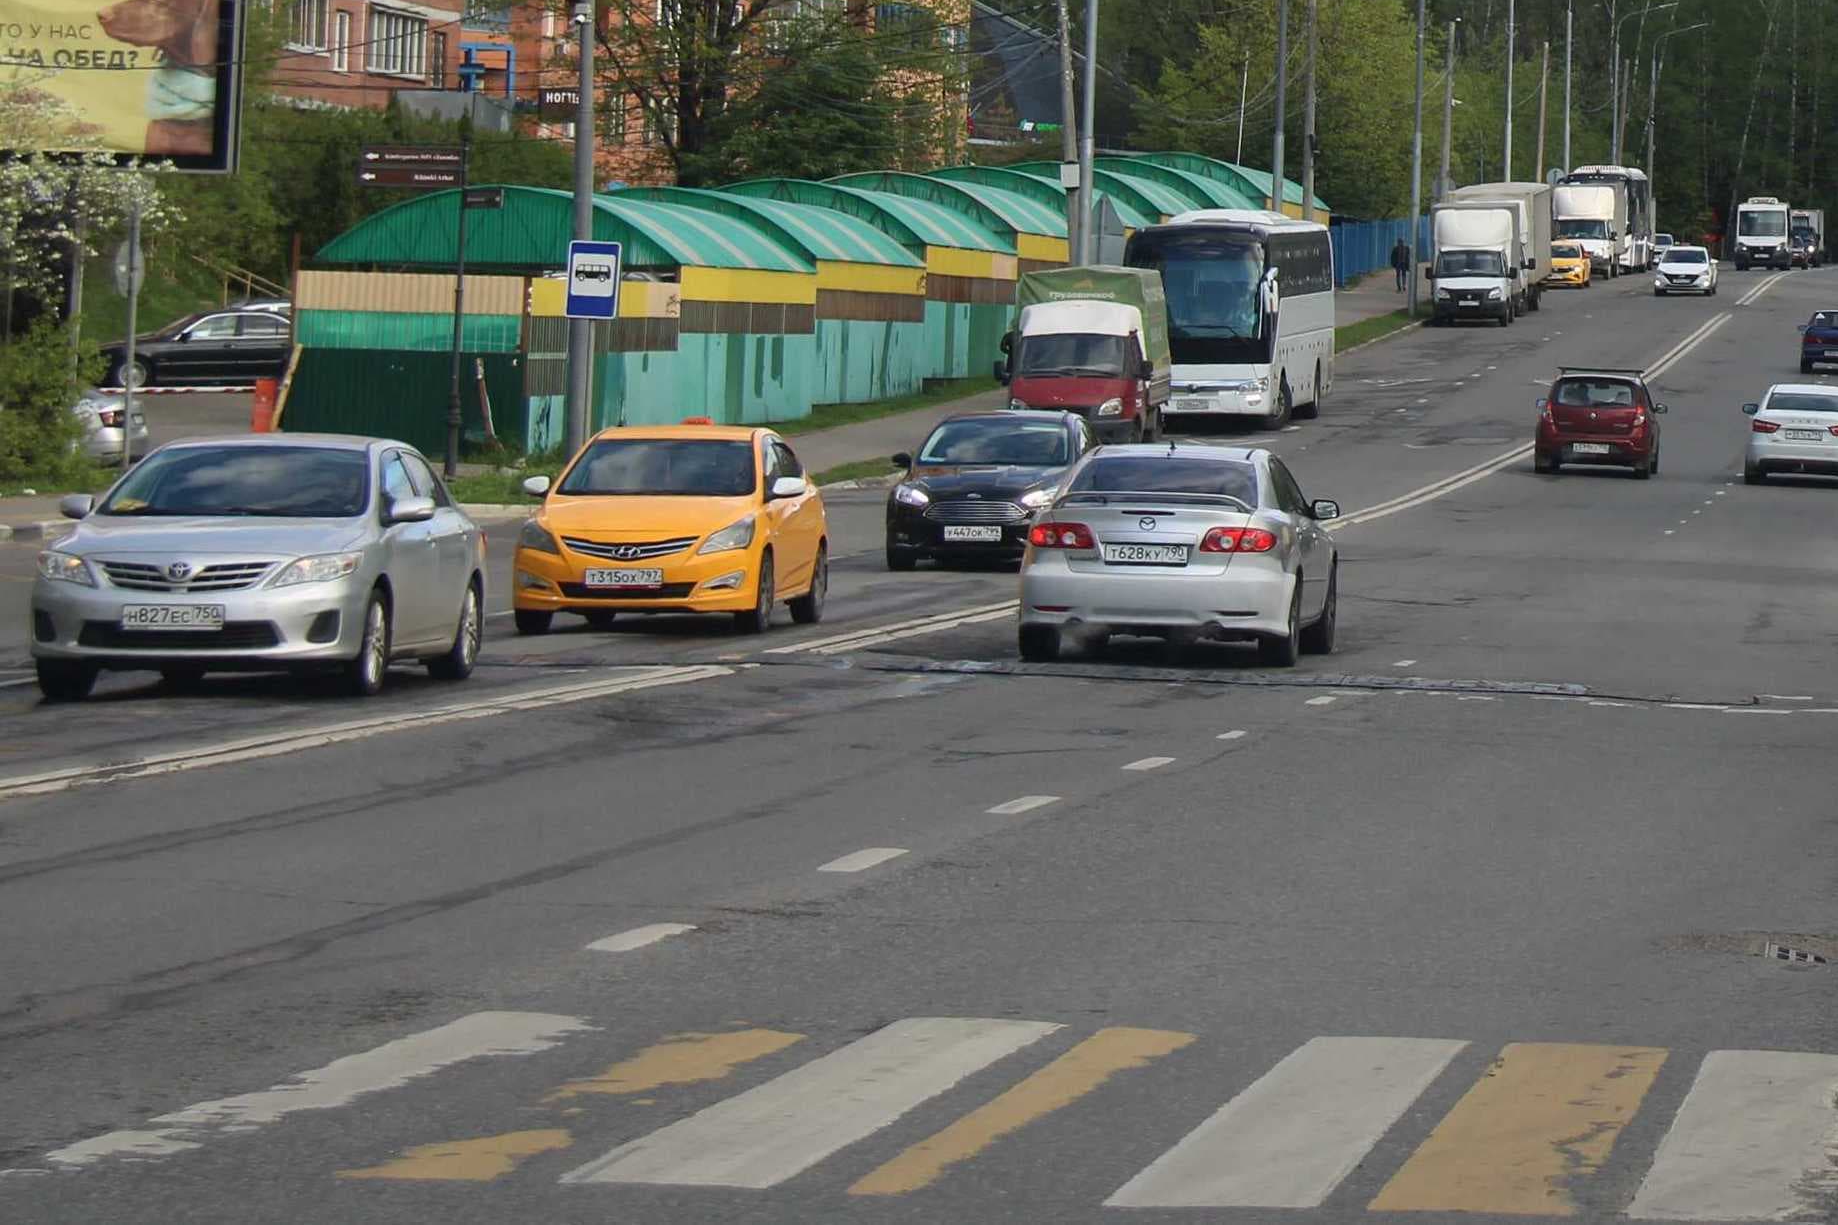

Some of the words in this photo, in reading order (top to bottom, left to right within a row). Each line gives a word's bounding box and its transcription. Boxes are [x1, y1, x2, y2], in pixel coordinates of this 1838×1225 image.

[31, 24, 42, 39] У
[50, 24, 93, 39] НАС
[54, 49, 138, 69] ОБЕД?
